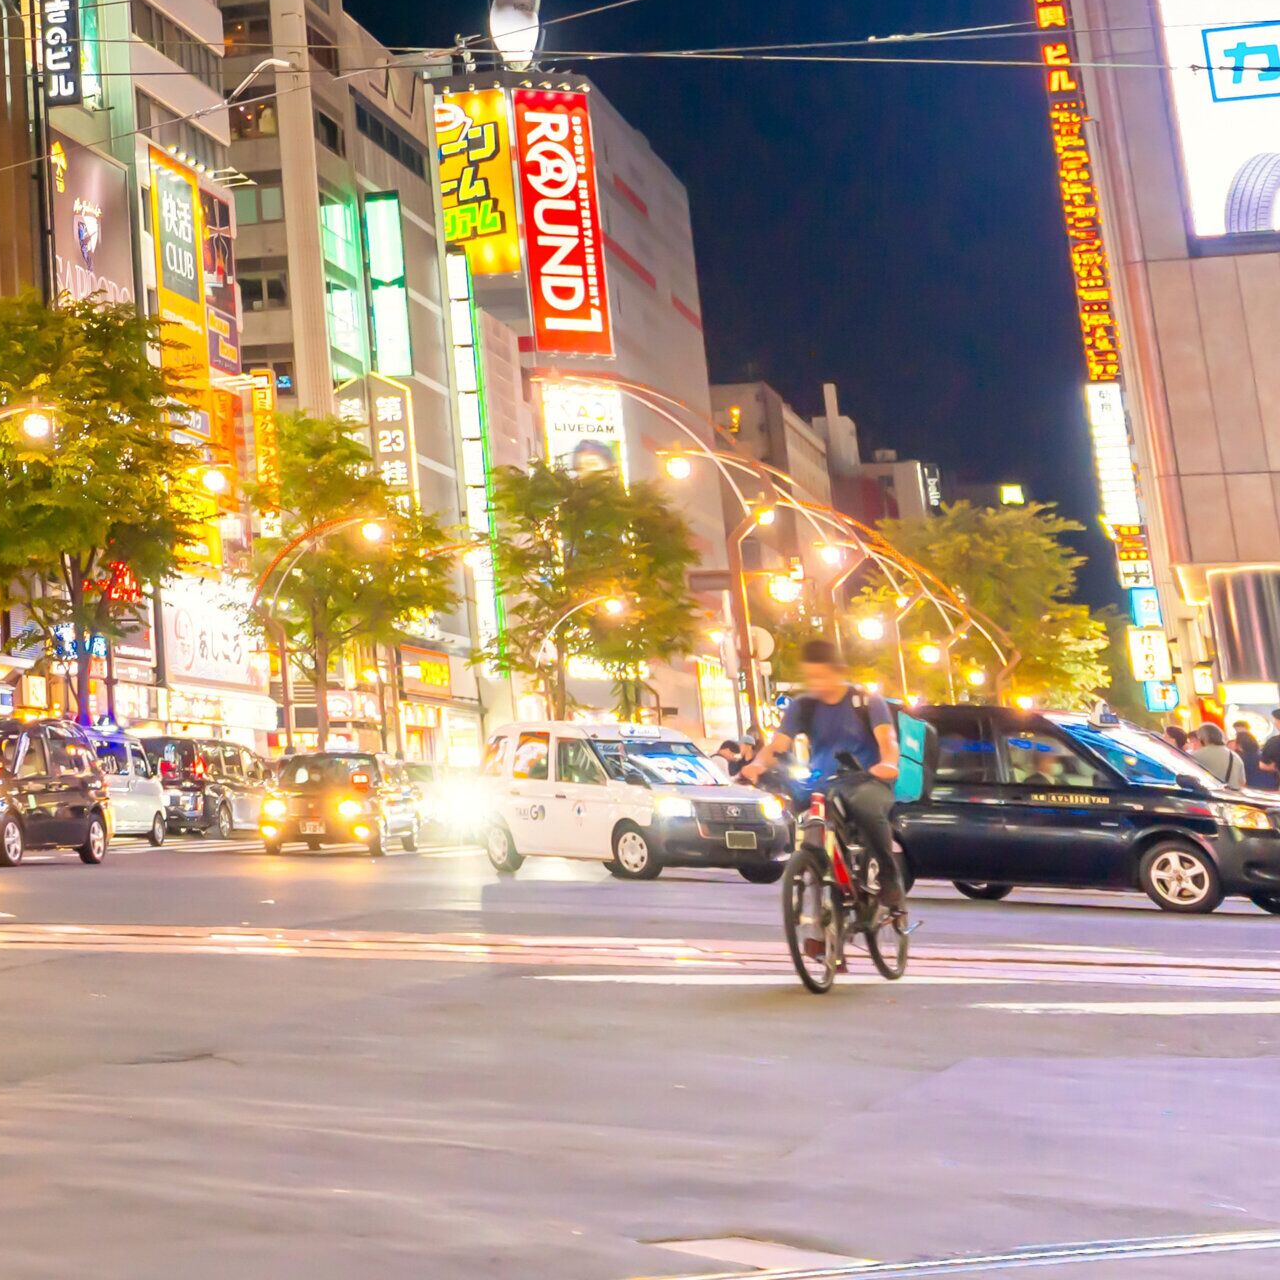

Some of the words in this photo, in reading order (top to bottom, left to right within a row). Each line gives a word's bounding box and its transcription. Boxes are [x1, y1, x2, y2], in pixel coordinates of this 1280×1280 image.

[572, 116, 587, 174] SPORTS
[162, 190, 192, 244] 快活
[524, 111, 604, 333] ROUND1
[578, 179, 600, 308] ENTERTAINMENT
[166, 242, 194, 281] CLUB
[554, 423, 615, 434] LIVEDAM
[927, 477, 940, 507] belle
